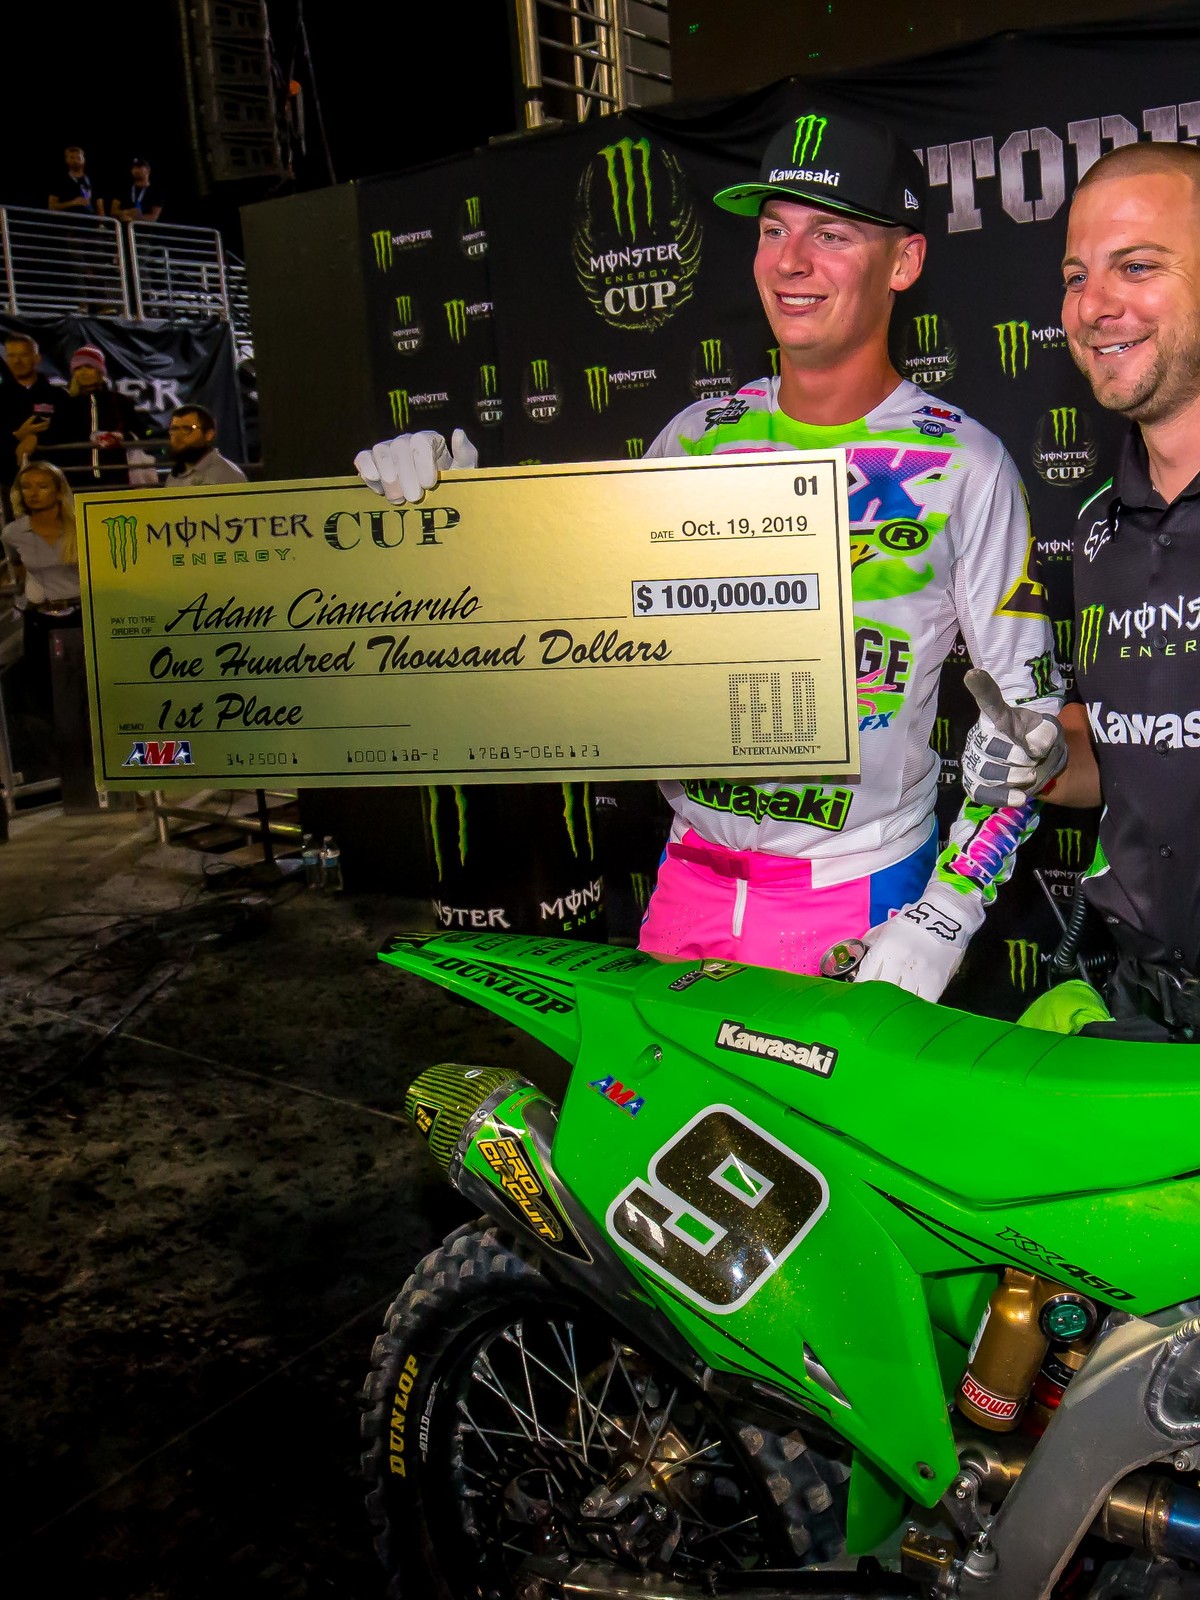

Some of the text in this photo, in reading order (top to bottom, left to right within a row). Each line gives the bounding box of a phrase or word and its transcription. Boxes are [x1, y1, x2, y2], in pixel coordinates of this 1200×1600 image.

[768, 168, 841, 187] Kawasaki
[590, 243, 682, 274] MONSTER
[604, 268, 668, 285] ENERGY
[604, 280, 677, 316] CUP
[397, 340, 418, 350] CUP
[905, 355, 949, 367] MONSTER
[608, 369, 657, 384] MONSTER
[694, 377, 733, 387] MONSTER
[911, 370, 947, 384] CUP
[531, 406, 556, 418] CUP
[912, 406, 962, 423] AMA
[925, 424, 942, 434] FIM
[1040, 451, 1089, 462] MONSTER
[794, 475, 819, 496] 01
[1046, 467, 1085, 479] CUP
[146, 506, 461, 551] MONSTER CUP
[650, 515, 808, 540] DATE Oct. 19, 2019
[172, 548, 292, 567] ENERGY
[637, 579, 807, 612] $ 100,000.00
[111, 615, 156, 625] PAY TO THE
[164, 585, 483, 634] Adam Cianciarulo
[111, 626, 152, 636] ORDER OF
[150, 629, 672, 679] One Hundred Thousand Dollars
[119, 693, 304, 731] MEMO 1st Place
[728, 671, 817, 743] FELD
[122, 740, 195, 767] AMA
[1051, 885, 1075, 897] CU
[432, 957, 577, 1015] DUNLOP
[717, 1022, 836, 1076] Kawasaki
[587, 1074, 647, 1120] AMA
[498, 1140, 541, 1195] PRO
[478, 1141, 556, 1241] CIRCUIT
[605, 1103, 830, 1315] 9
[962, 1376, 1017, 1420] SHOWA
[389, 1355, 420, 1478] DUNLOP
